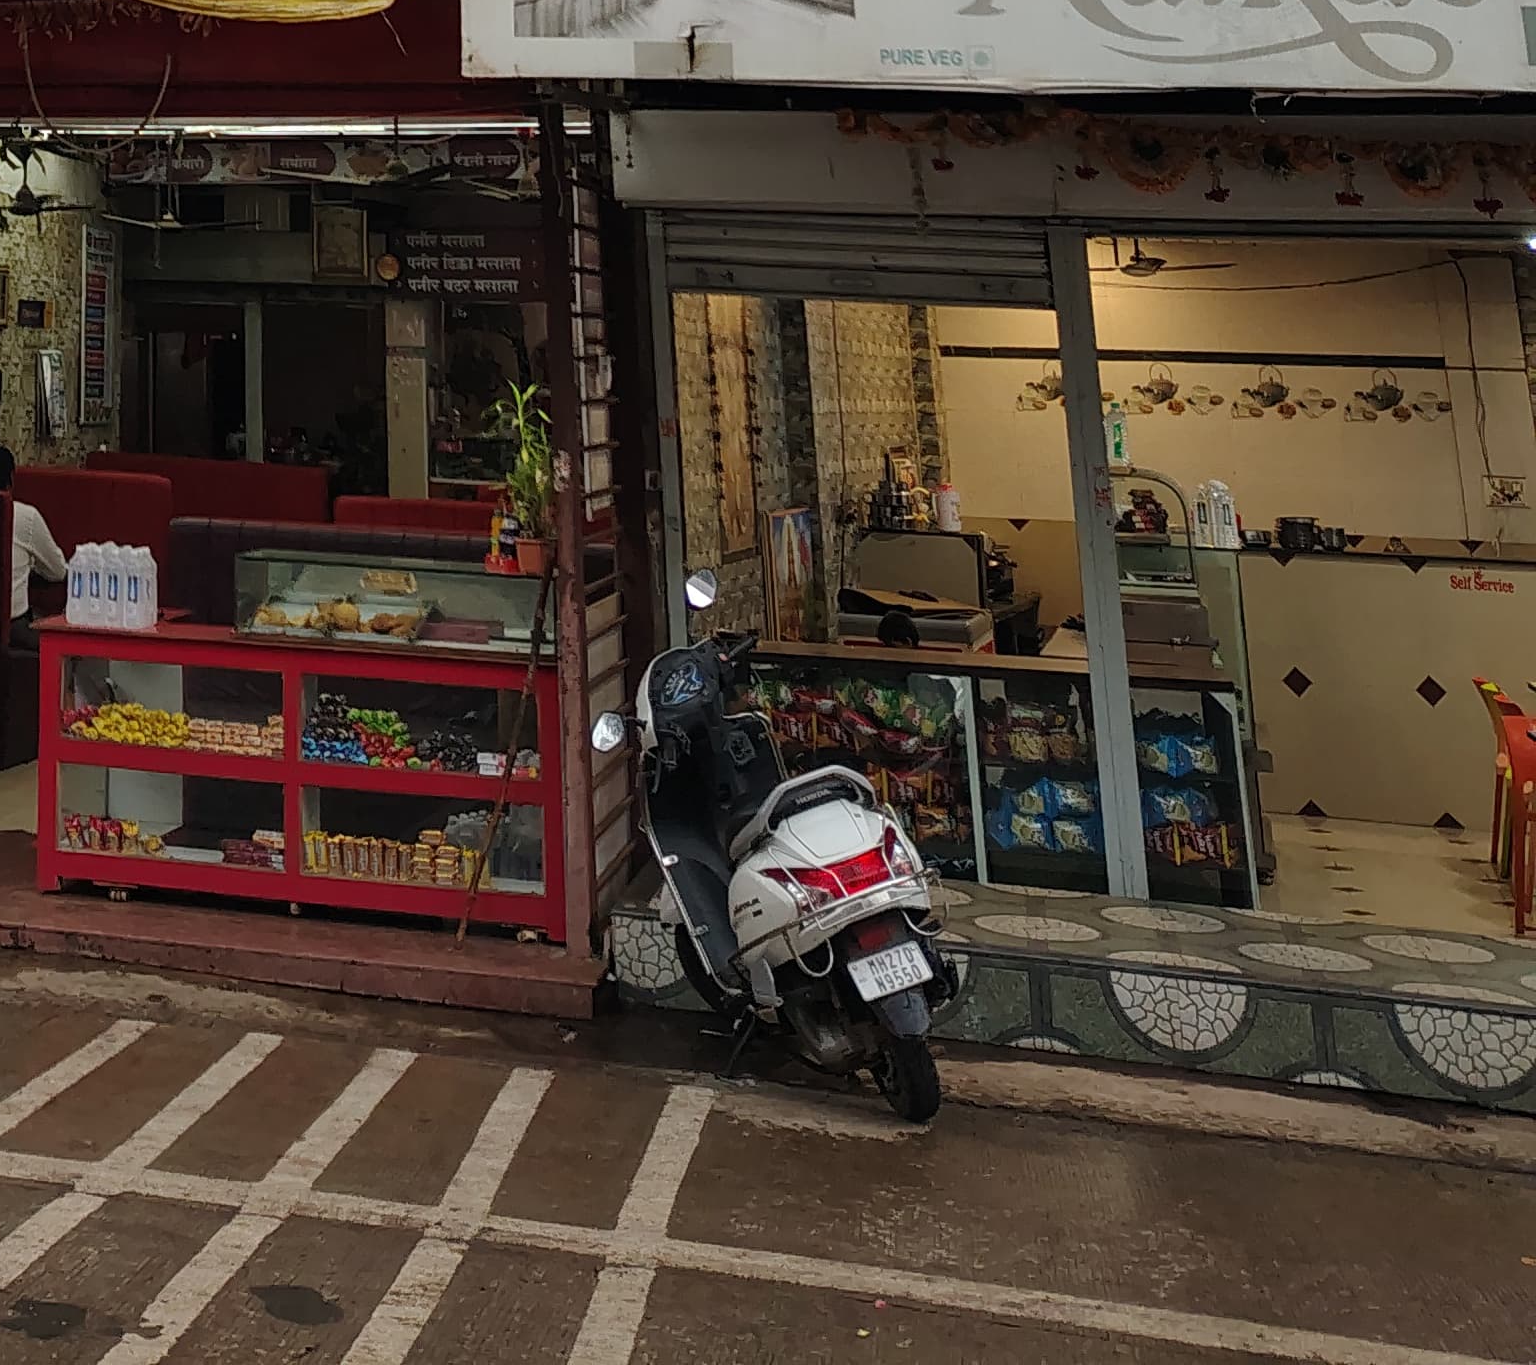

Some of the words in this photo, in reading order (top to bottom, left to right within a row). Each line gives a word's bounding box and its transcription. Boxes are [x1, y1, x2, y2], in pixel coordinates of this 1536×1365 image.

[879, 48, 921, 66] PURE
[923, 48, 962, 66] VEG
[407, 274, 441, 292] पनीर
[472, 278, 520, 293] मसाला
[1450, 574, 1471, 590] Self
[1474, 576, 1514, 593] Service
